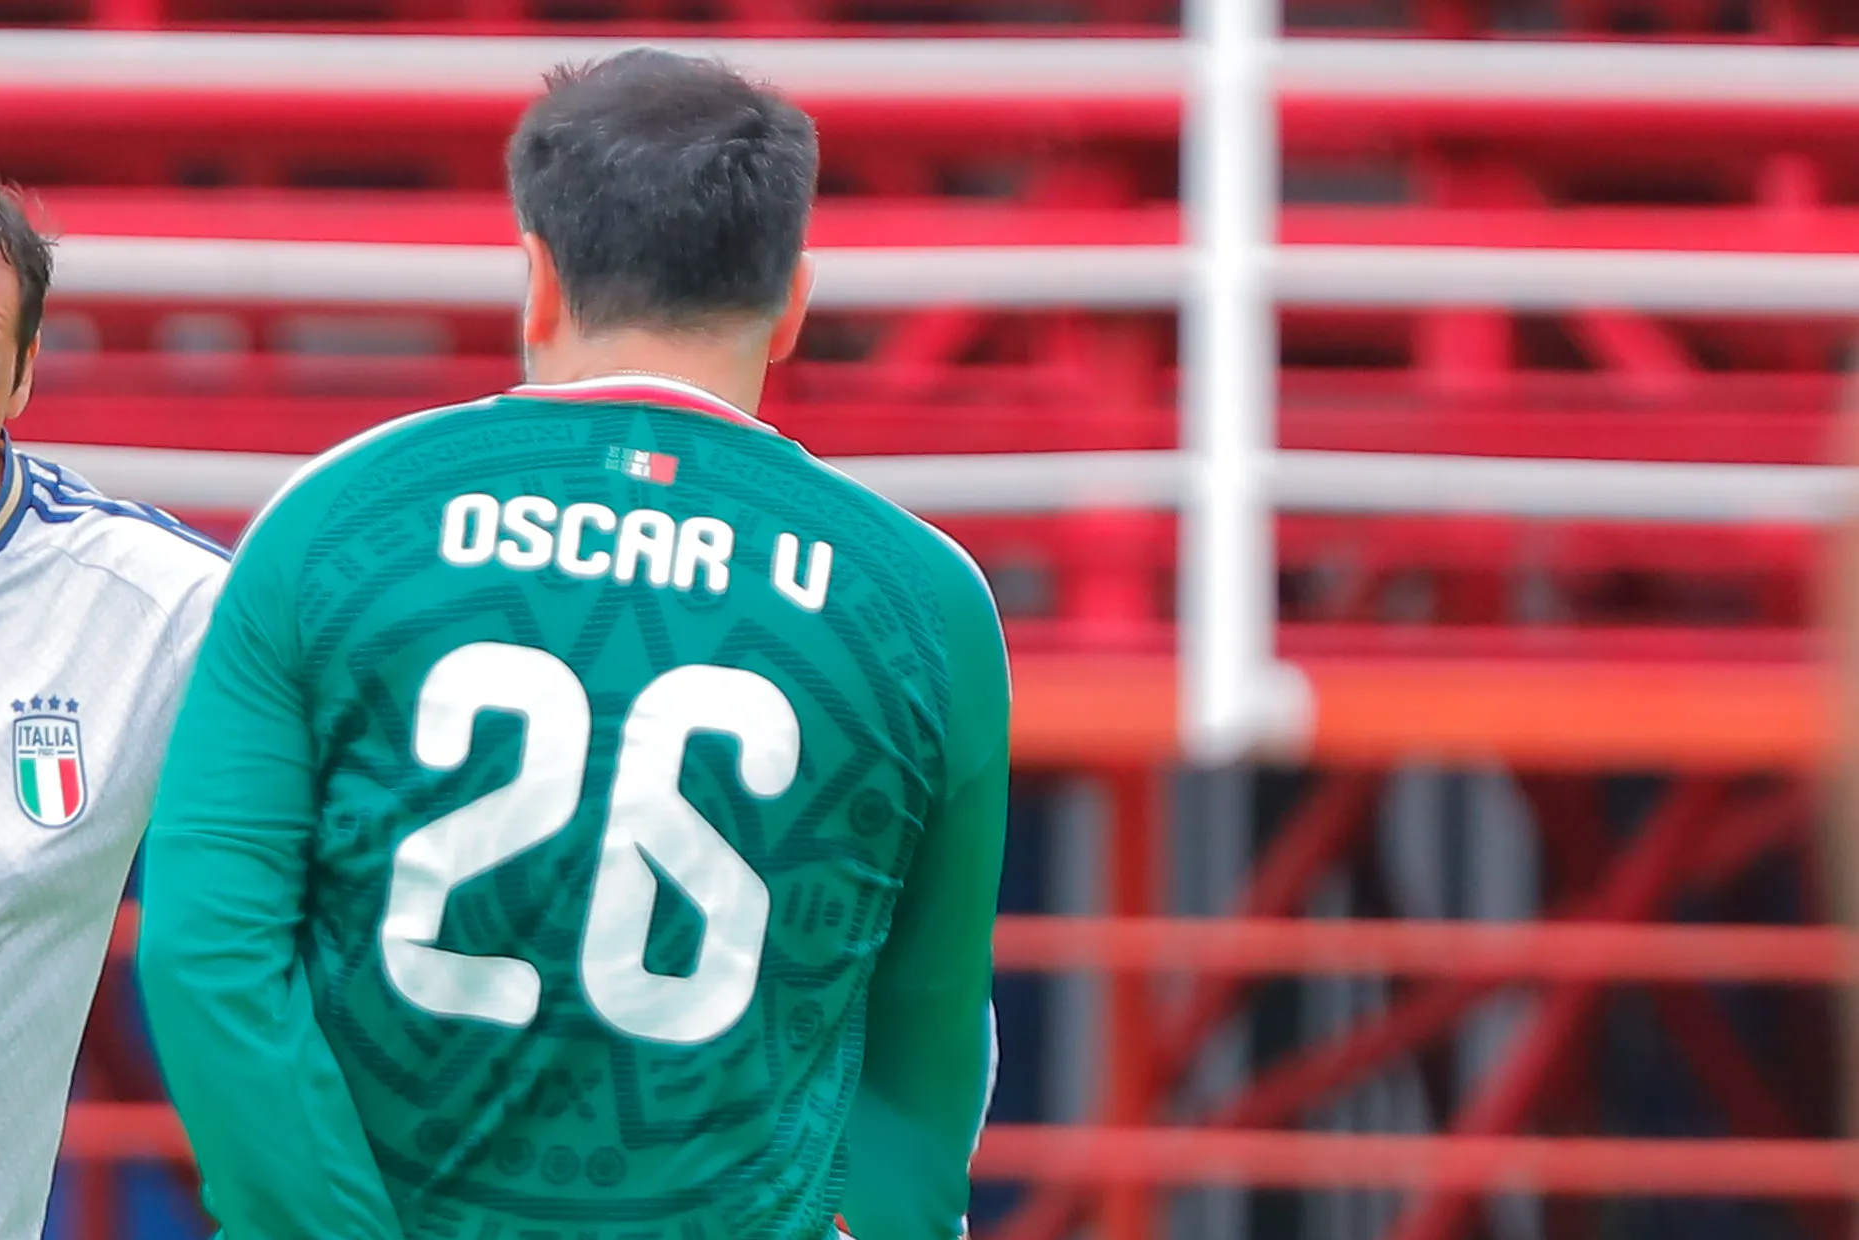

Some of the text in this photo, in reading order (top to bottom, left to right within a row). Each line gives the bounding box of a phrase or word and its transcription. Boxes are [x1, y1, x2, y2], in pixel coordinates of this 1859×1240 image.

[442, 493, 734, 594] OSCAR
[18, 725, 74, 747] ITALIA
[380, 641, 801, 1045] 26
